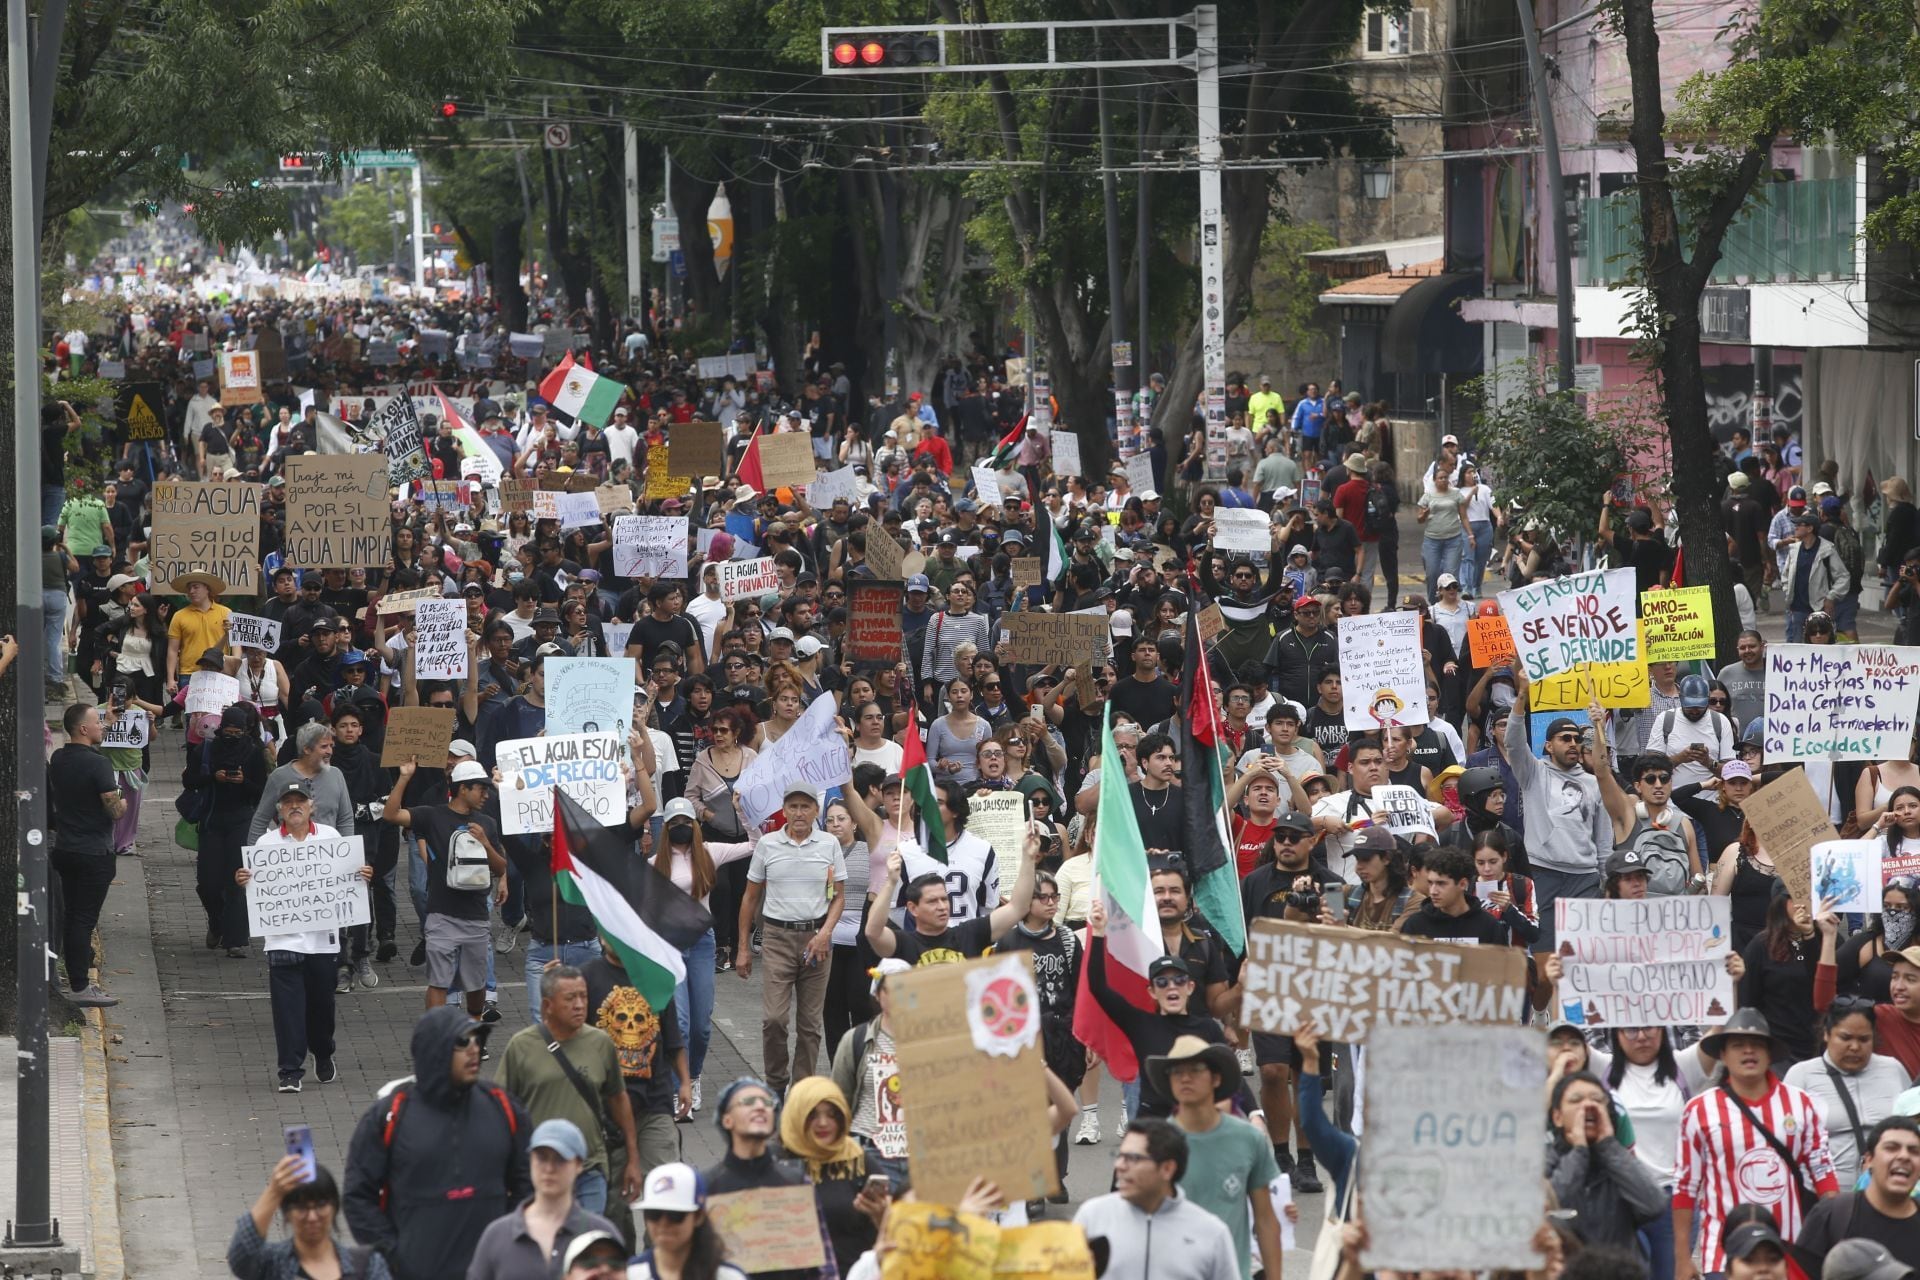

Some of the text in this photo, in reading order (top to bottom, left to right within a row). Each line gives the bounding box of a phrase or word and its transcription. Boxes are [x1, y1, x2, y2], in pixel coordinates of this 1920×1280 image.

[128, 426, 164, 439] JALISCO
[403, 424, 415, 433] LAS
[287, 464, 355, 486] Traje mi
[155, 486, 257, 515] NO ES AGUA
[288, 482, 365, 504] garrafón
[155, 500, 192, 514] SOLO
[304, 503, 361, 518] POR SI
[191, 526, 254, 544] salud
[289, 517, 392, 534] AVIENTA
[155, 533, 256, 559] ES VIDA
[286, 535, 392, 564] AGUA LIMPIA
[724, 560, 774, 580] EL AGUA NO
[724, 575, 778, 597] SE PRIVATIZA
[1516, 573, 1607, 613] EL AGUA
[419, 603, 427, 613] SI
[1575, 594, 1599, 616] NO
[417, 623, 427, 633] EN
[427, 622, 437, 633] EL
[1475, 619, 1502, 630] NO A
[1522, 605, 1628, 643] SE VENDE
[1643, 612, 1699, 626] OTRA FORMA
[1663, 623, 1676, 632] DE
[232, 623, 261, 635] AGUA
[417, 632, 450, 643] EL AGUA
[1481, 629, 1510, 643] REPRE
[1647, 627, 1704, 644] RIVATIZACIÓN
[418, 641, 458, 654] VA A OLER
[1022, 648, 1031, 660] a
[1354, 651, 1366, 659] dan
[1367, 650, 1375, 658] lo
[1477, 641, 1512, 654] SI A LA
[417, 652, 466, 668] A MUERTE!
[1373, 659, 1392, 667] morir
[1525, 647, 1559, 679] SE
[1559, 637, 1637, 667] DEFIENDE
[1772, 653, 1793, 674] No
[1810, 652, 1852, 679] Mega
[1784, 673, 1866, 692] Industrias
[1768, 691, 1876, 713] Data Centers
[1768, 717, 1791, 735] No
[1795, 723, 1804, 733] a
[1808, 713, 1822, 733] la
[519, 745, 541, 767] EL
[544, 739, 580, 764] AGUA
[1764, 736, 1784, 753] ca
[523, 760, 618, 789] DERECHO,
[547, 782, 597, 798] NO UN
[517, 797, 610, 825] PRIVGIO.
[982, 798, 1018, 812] JALISCO!!!
[1384, 799, 1420, 813] AGU
[1386, 812, 1398, 828] NO
[253, 863, 332, 883] CORRUPTO
[1882, 860, 1900, 870] MEGA
[256, 871, 362, 897] INCOMPETENTE
[255, 886, 359, 912] TORTURADOR
[1600, 898, 1714, 935] EL PUEBLO
[1250, 931, 1462, 982] THE BADDEST
[1576, 931, 1705, 965] NO TIENE PAZ
[1248, 962, 1372, 1006] BITCHES
[1570, 961, 1717, 993] EL GOBIERNO
[1240, 991, 1302, 1033] POR
[1596, 991, 1705, 1024] TAMPOCO!!
[1412, 1111, 1519, 1148] AGUA
[885, 1146, 895, 1155] EL
